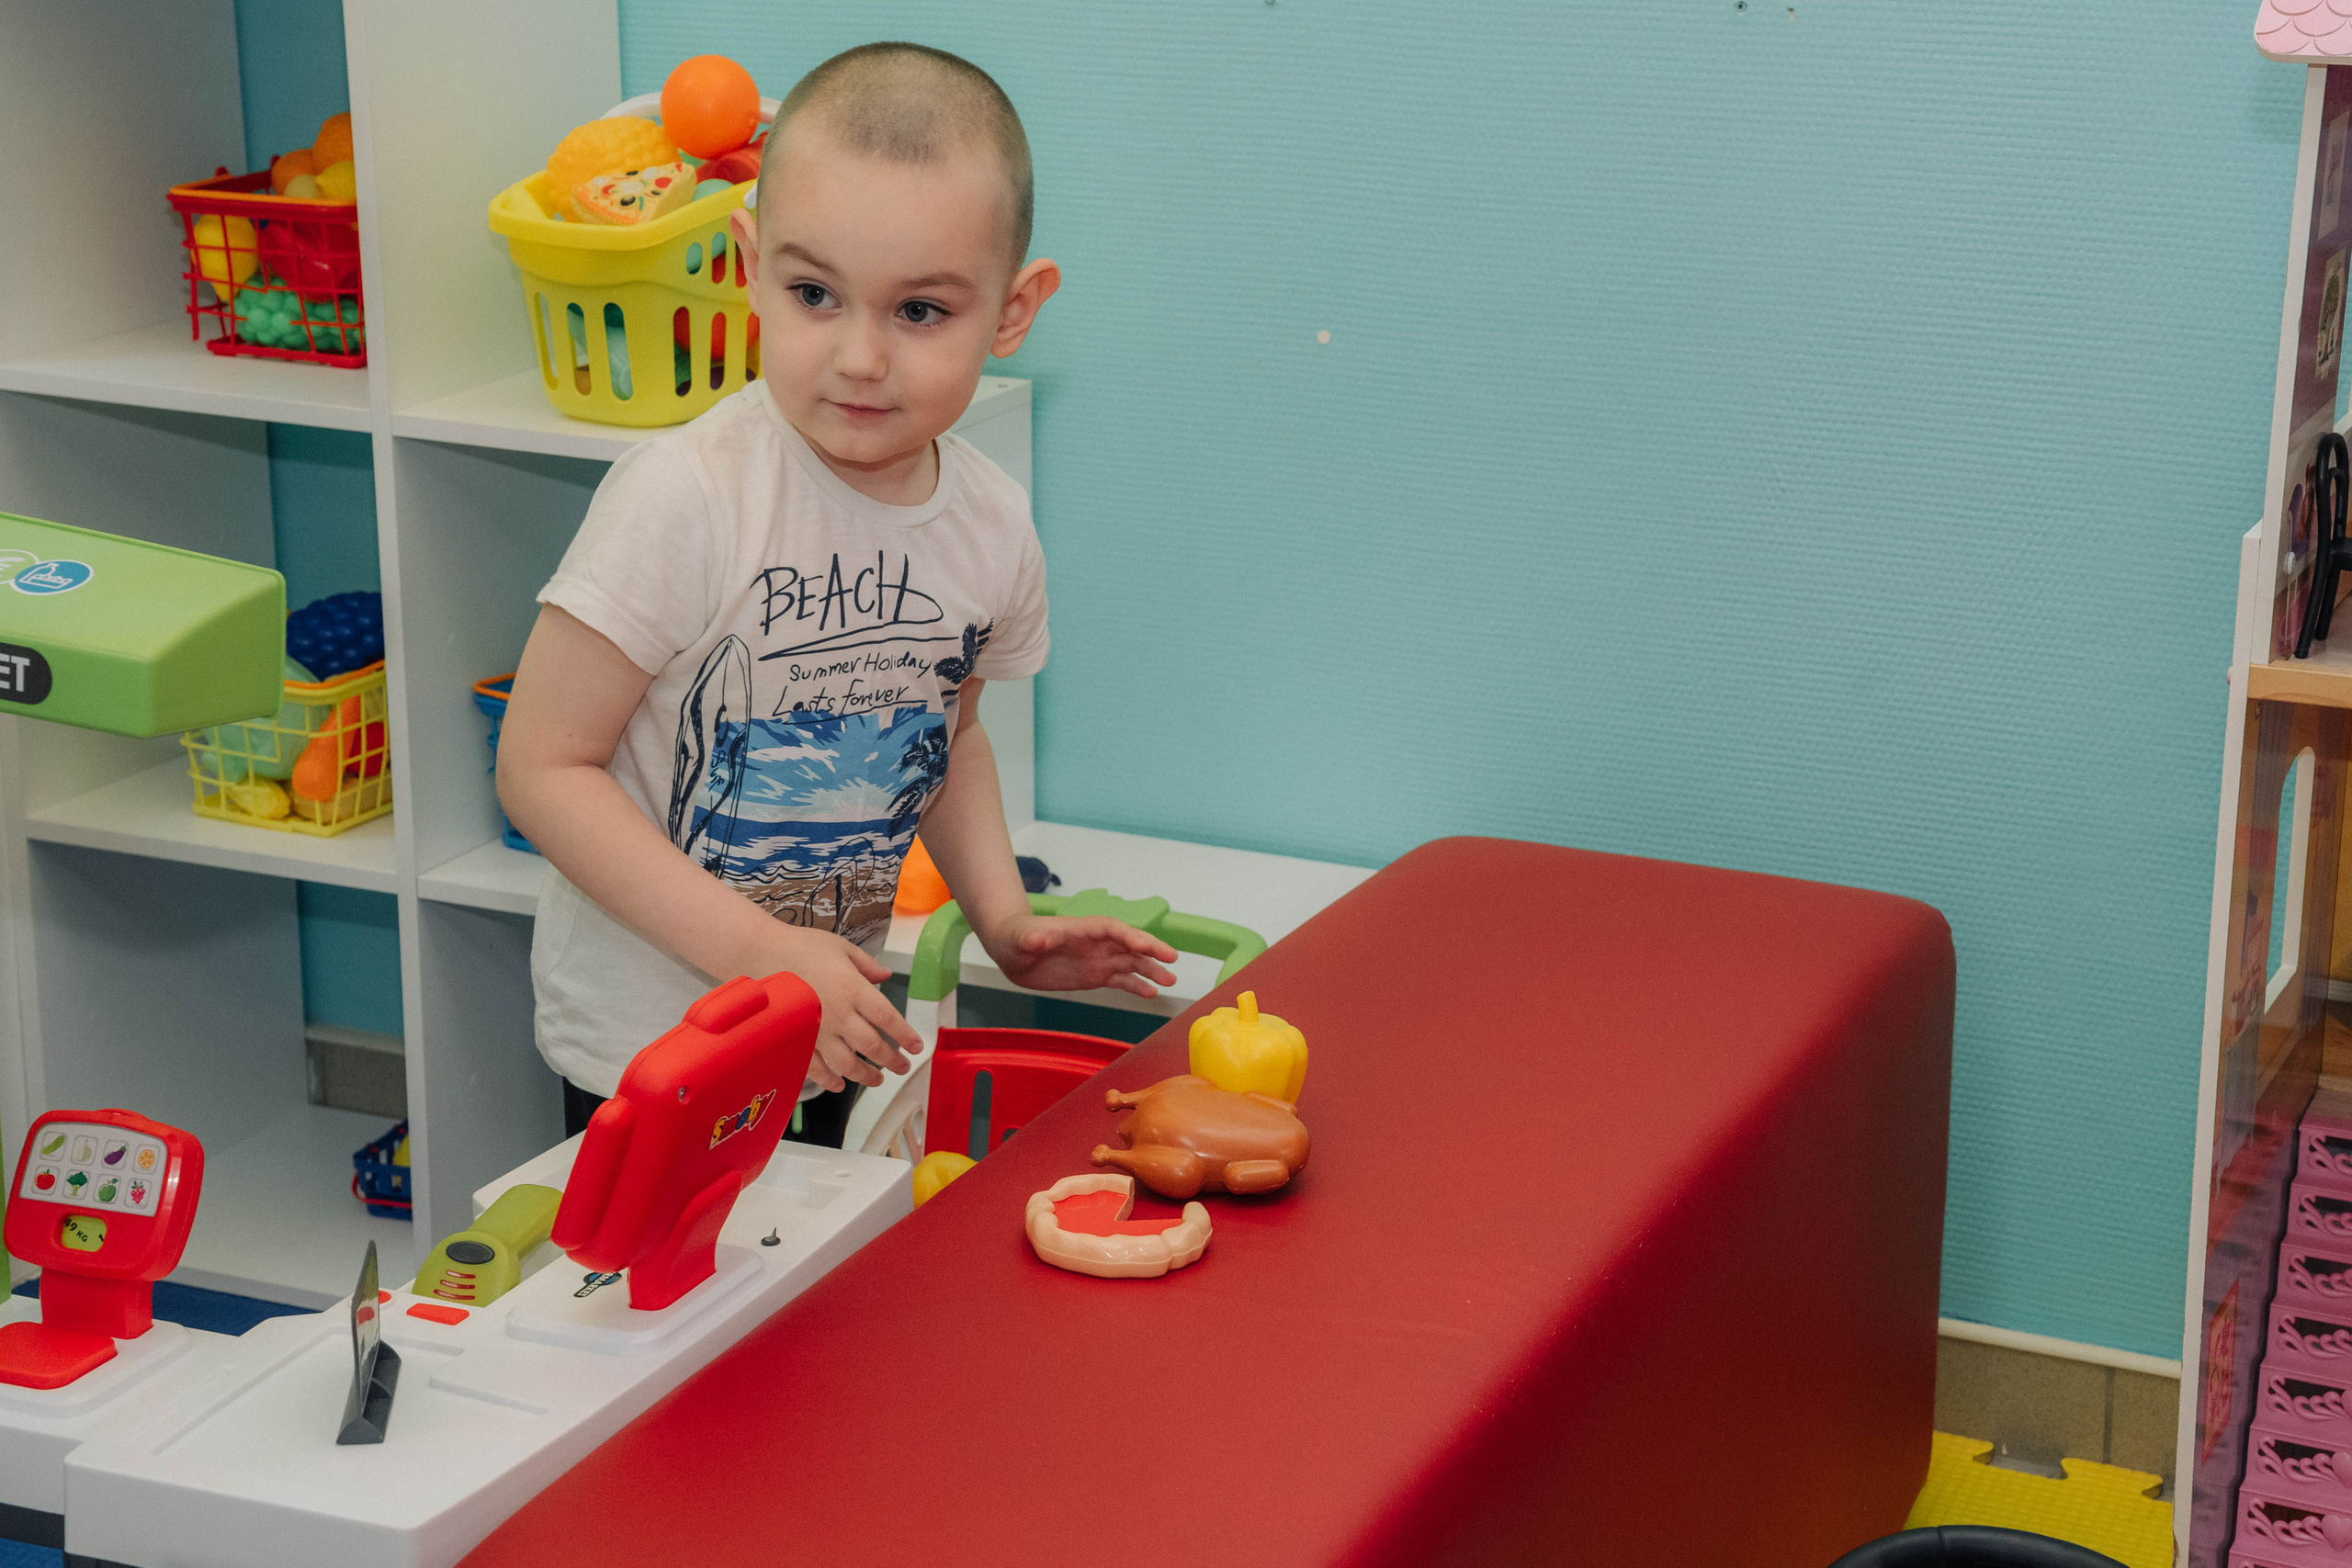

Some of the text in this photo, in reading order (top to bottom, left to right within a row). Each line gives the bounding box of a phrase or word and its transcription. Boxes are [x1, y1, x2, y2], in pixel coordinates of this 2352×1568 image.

[750, 550, 944, 636] BEACH
[789, 651, 932, 682] Summer Holiday
[772, 686, 835, 716] Lasts
